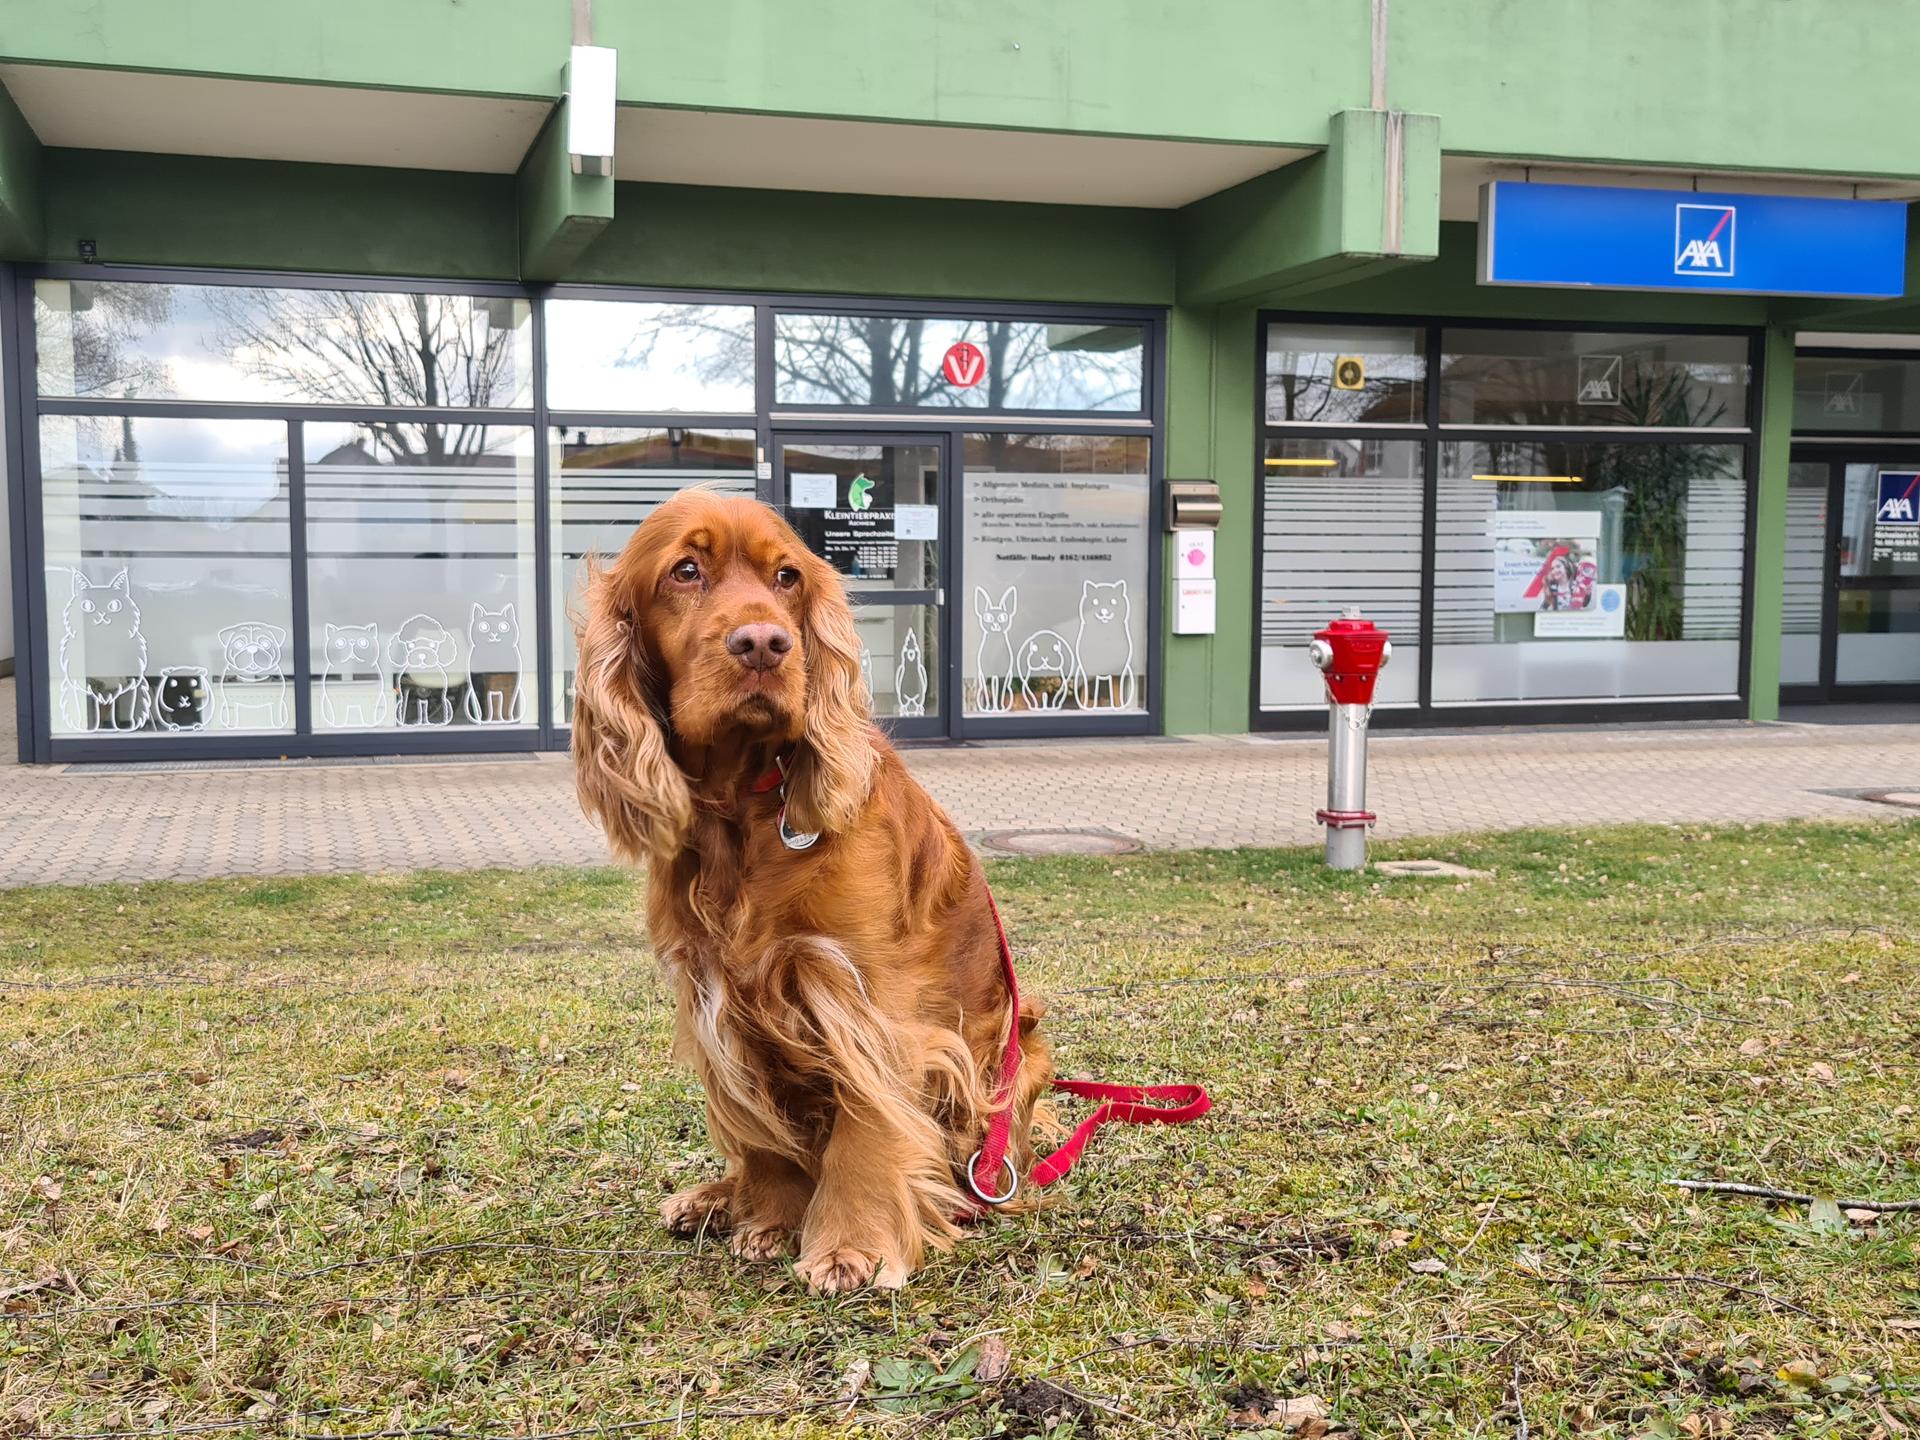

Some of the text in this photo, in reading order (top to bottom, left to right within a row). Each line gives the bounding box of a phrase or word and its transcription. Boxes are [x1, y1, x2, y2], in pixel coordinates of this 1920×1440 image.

[1677, 239, 1724, 268] AXA
[1877, 497, 1913, 520] AXA
[1031, 553, 1056, 562] Handy
